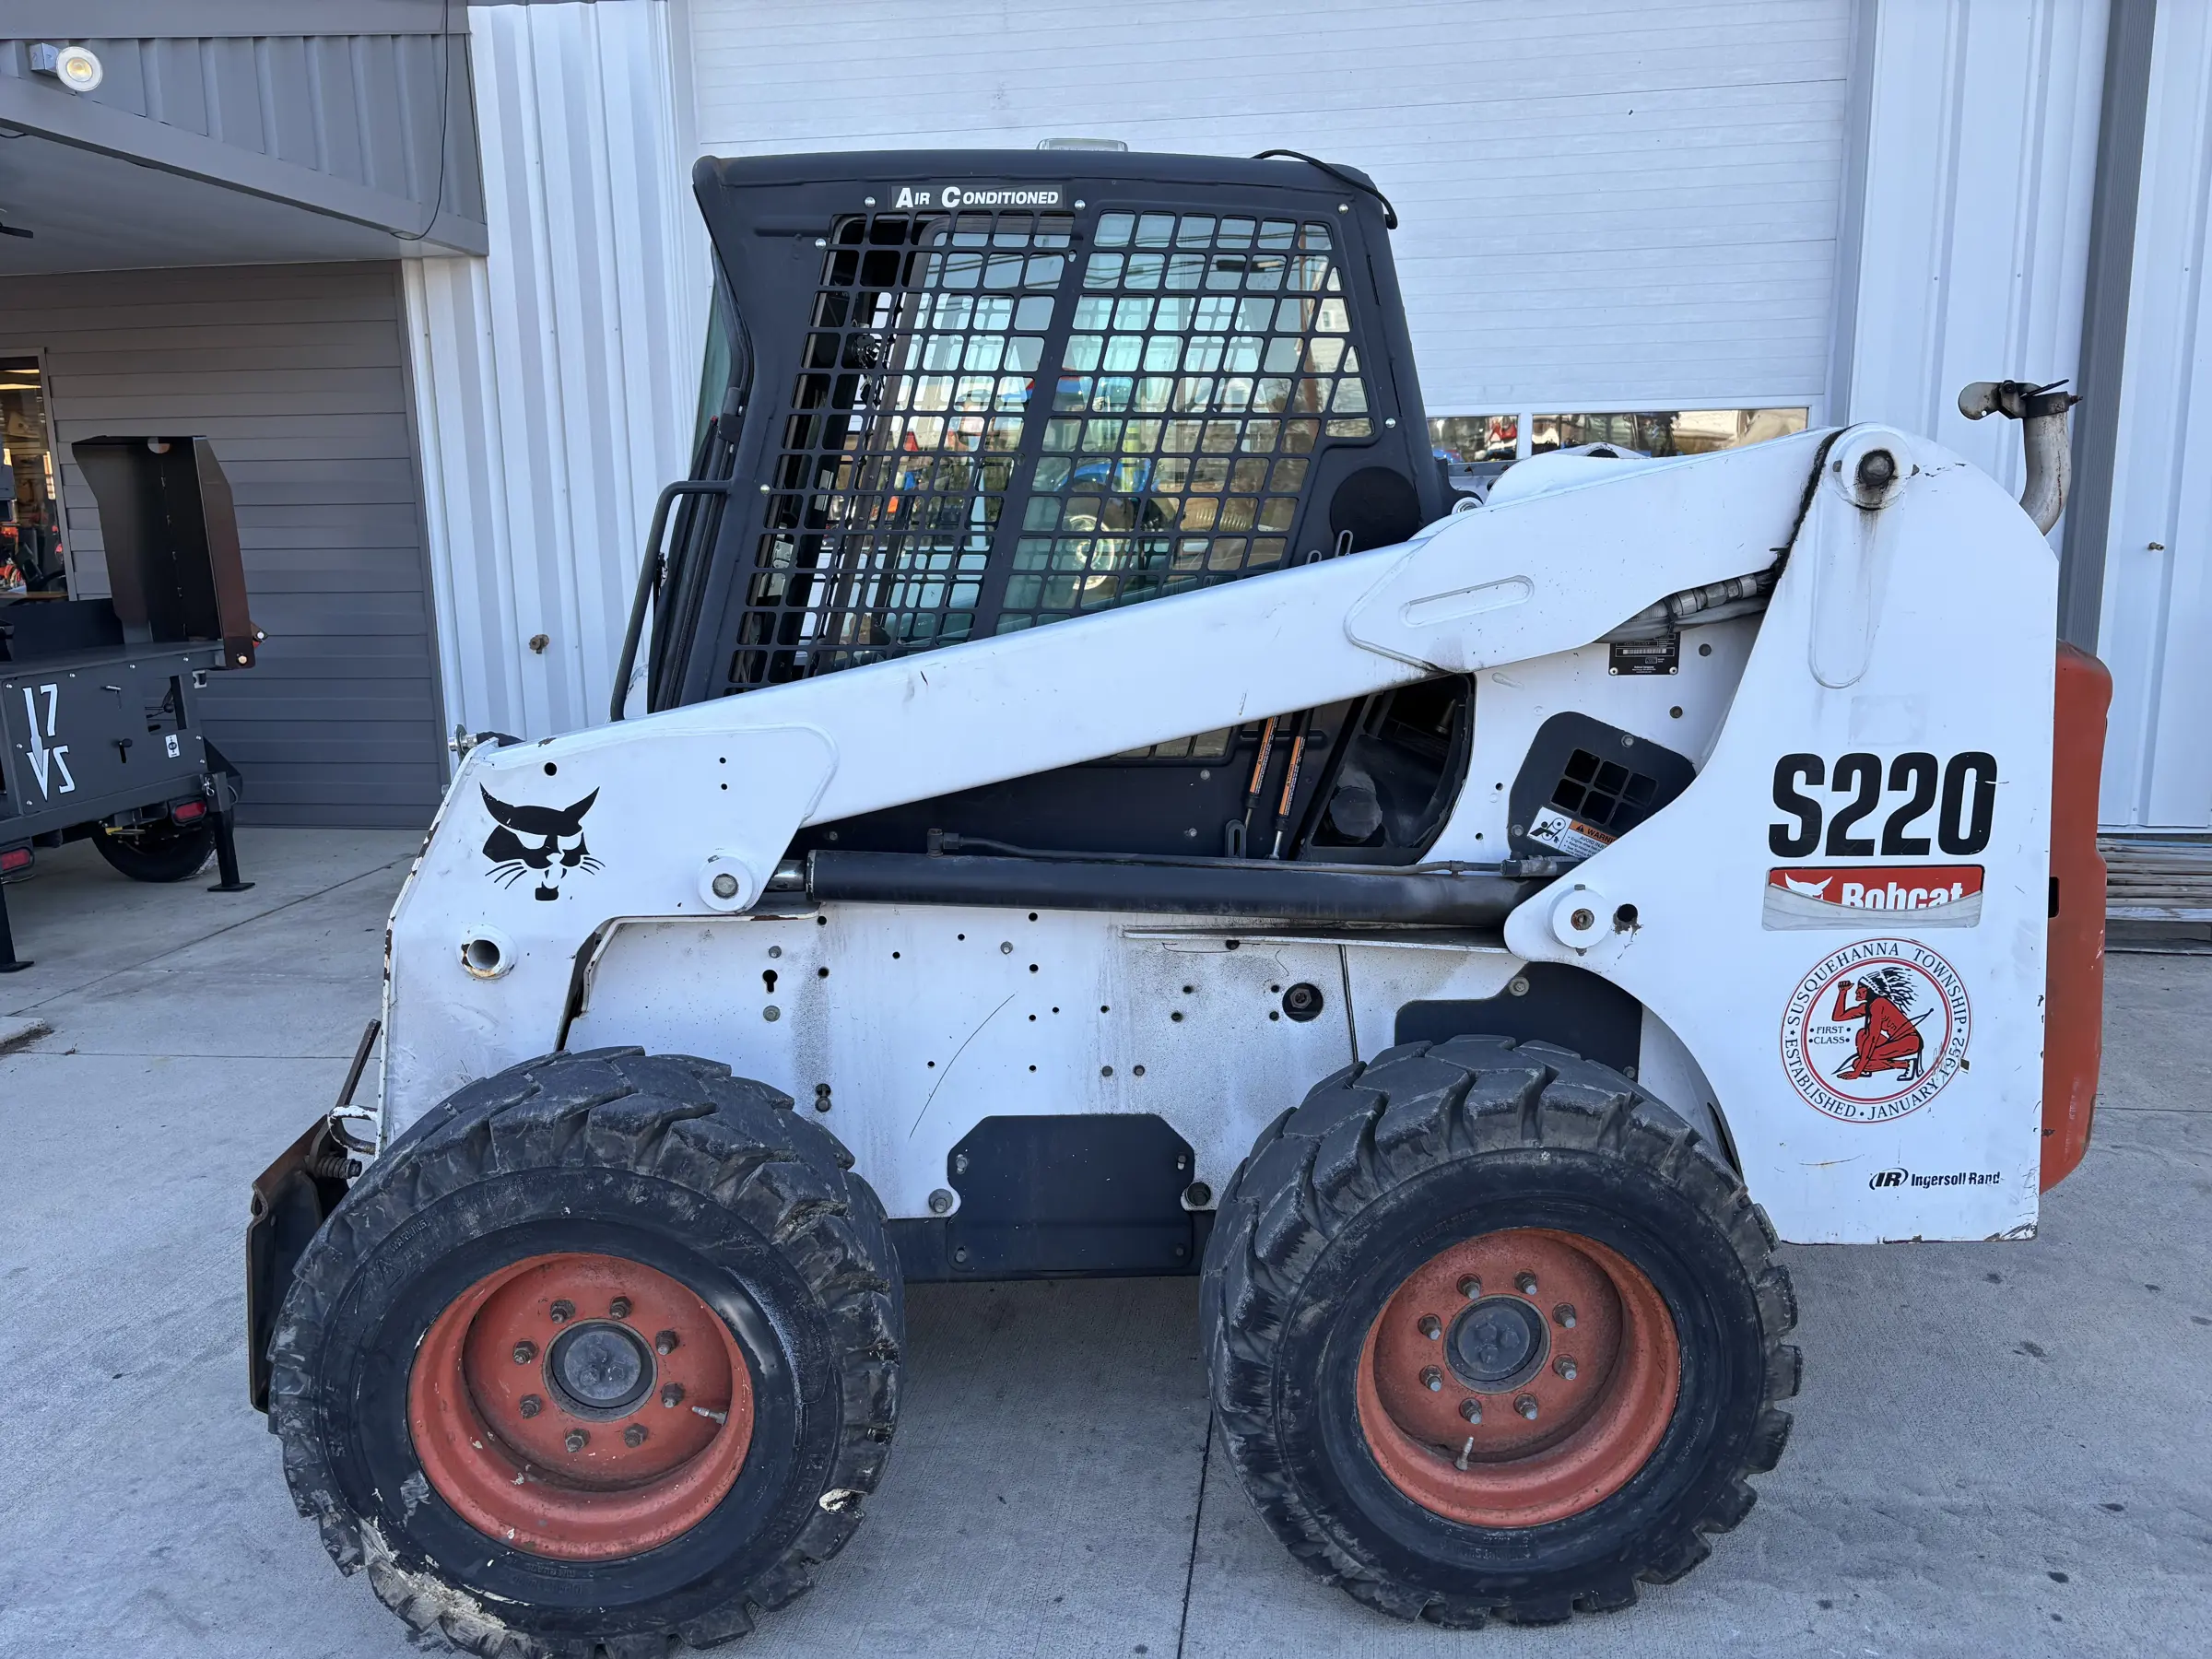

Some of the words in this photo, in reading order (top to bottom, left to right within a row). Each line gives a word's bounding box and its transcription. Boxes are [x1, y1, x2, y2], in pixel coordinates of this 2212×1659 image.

[895, 187, 931, 208] AIR
[941, 186, 1059, 208] CONDITIONED
[1769, 752, 1997, 858] S220
[1842, 882, 1963, 910] Bobcat
[1788, 942, 1900, 1027] SUSQUEHANNA
[1912, 947, 1967, 1025] TOWNSHIP
[1814, 1036, 1845, 1044] CLASS
[1817, 1026, 1844, 1034] FIRST
[1784, 1038, 1856, 1118] ESTABLISHED
[1867, 1077, 1939, 1120] JANUARY
[1940, 1038, 1965, 1077] 1952
[1911, 1171, 1967, 1189] Ingersoll
[1969, 1171, 2001, 1185] Rand
